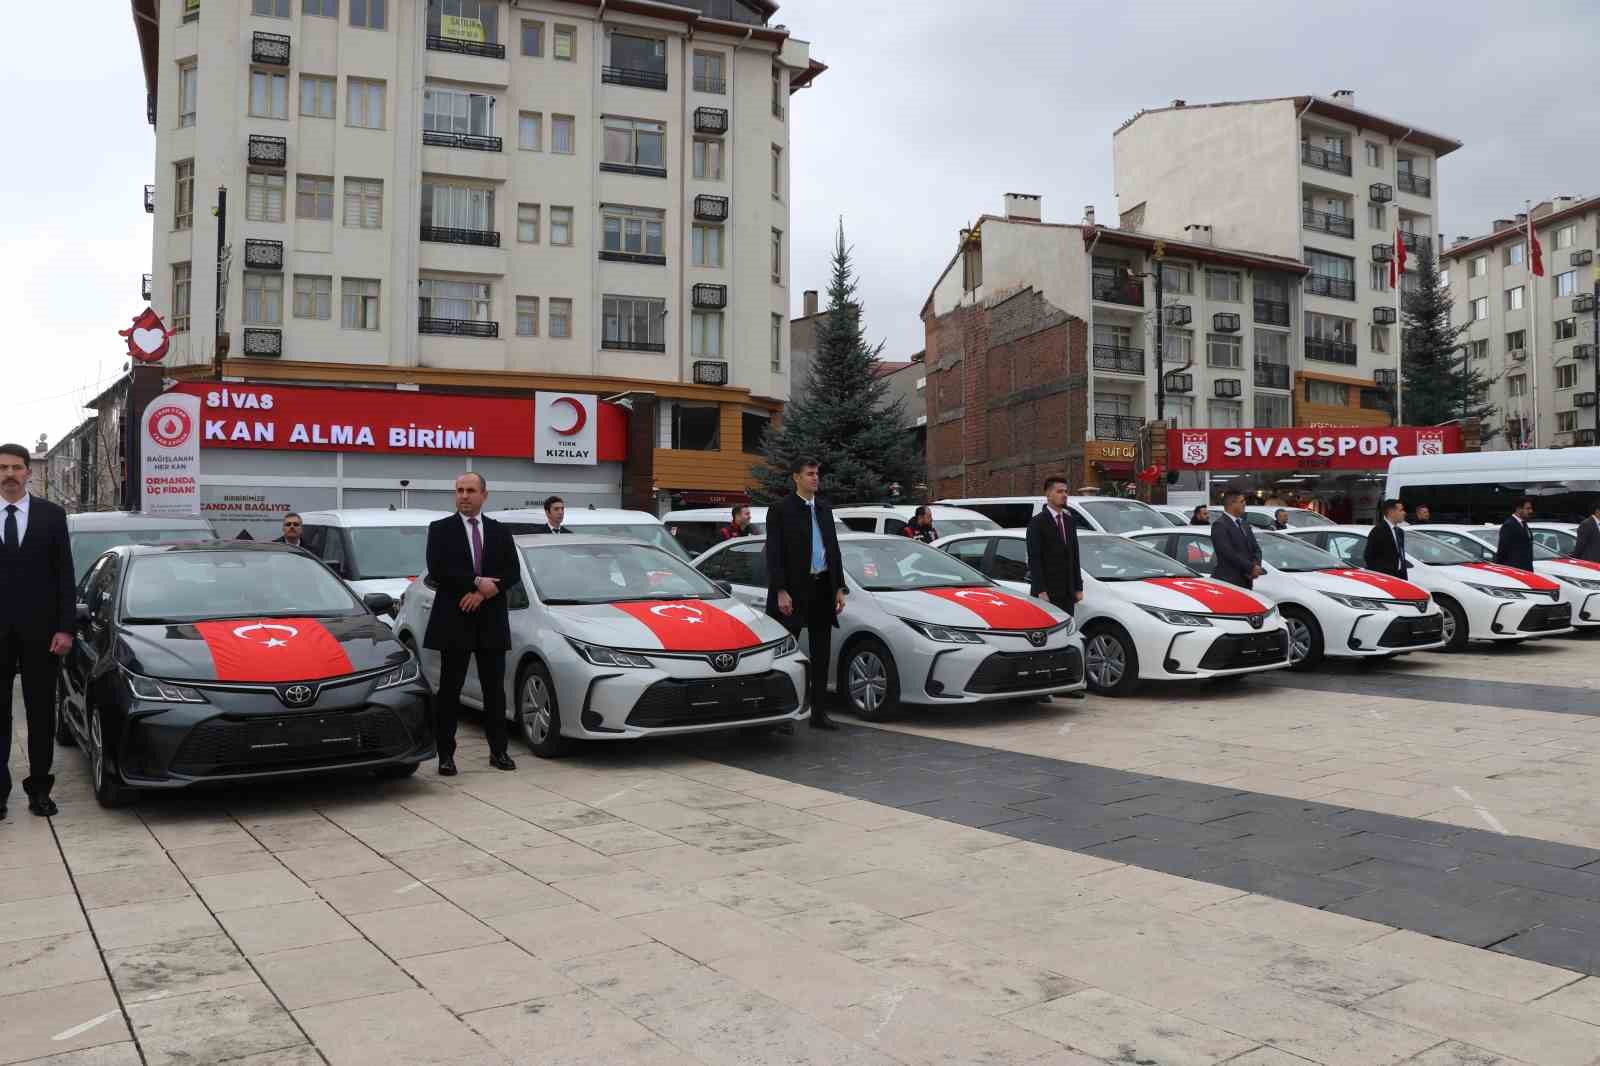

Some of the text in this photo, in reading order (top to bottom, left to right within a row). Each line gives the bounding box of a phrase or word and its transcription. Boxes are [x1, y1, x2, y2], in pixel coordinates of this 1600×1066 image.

[207, 389, 273, 409] SİVAS
[205, 420, 275, 442] KAN
[290, 424, 375, 446] ALMA
[388, 423, 475, 449] BİRİMİ
[1223, 431, 1399, 457] SİVASSPOR
[546, 449, 590, 458] KIZILAY
[146, 476, 195, 485] ORMANDA
